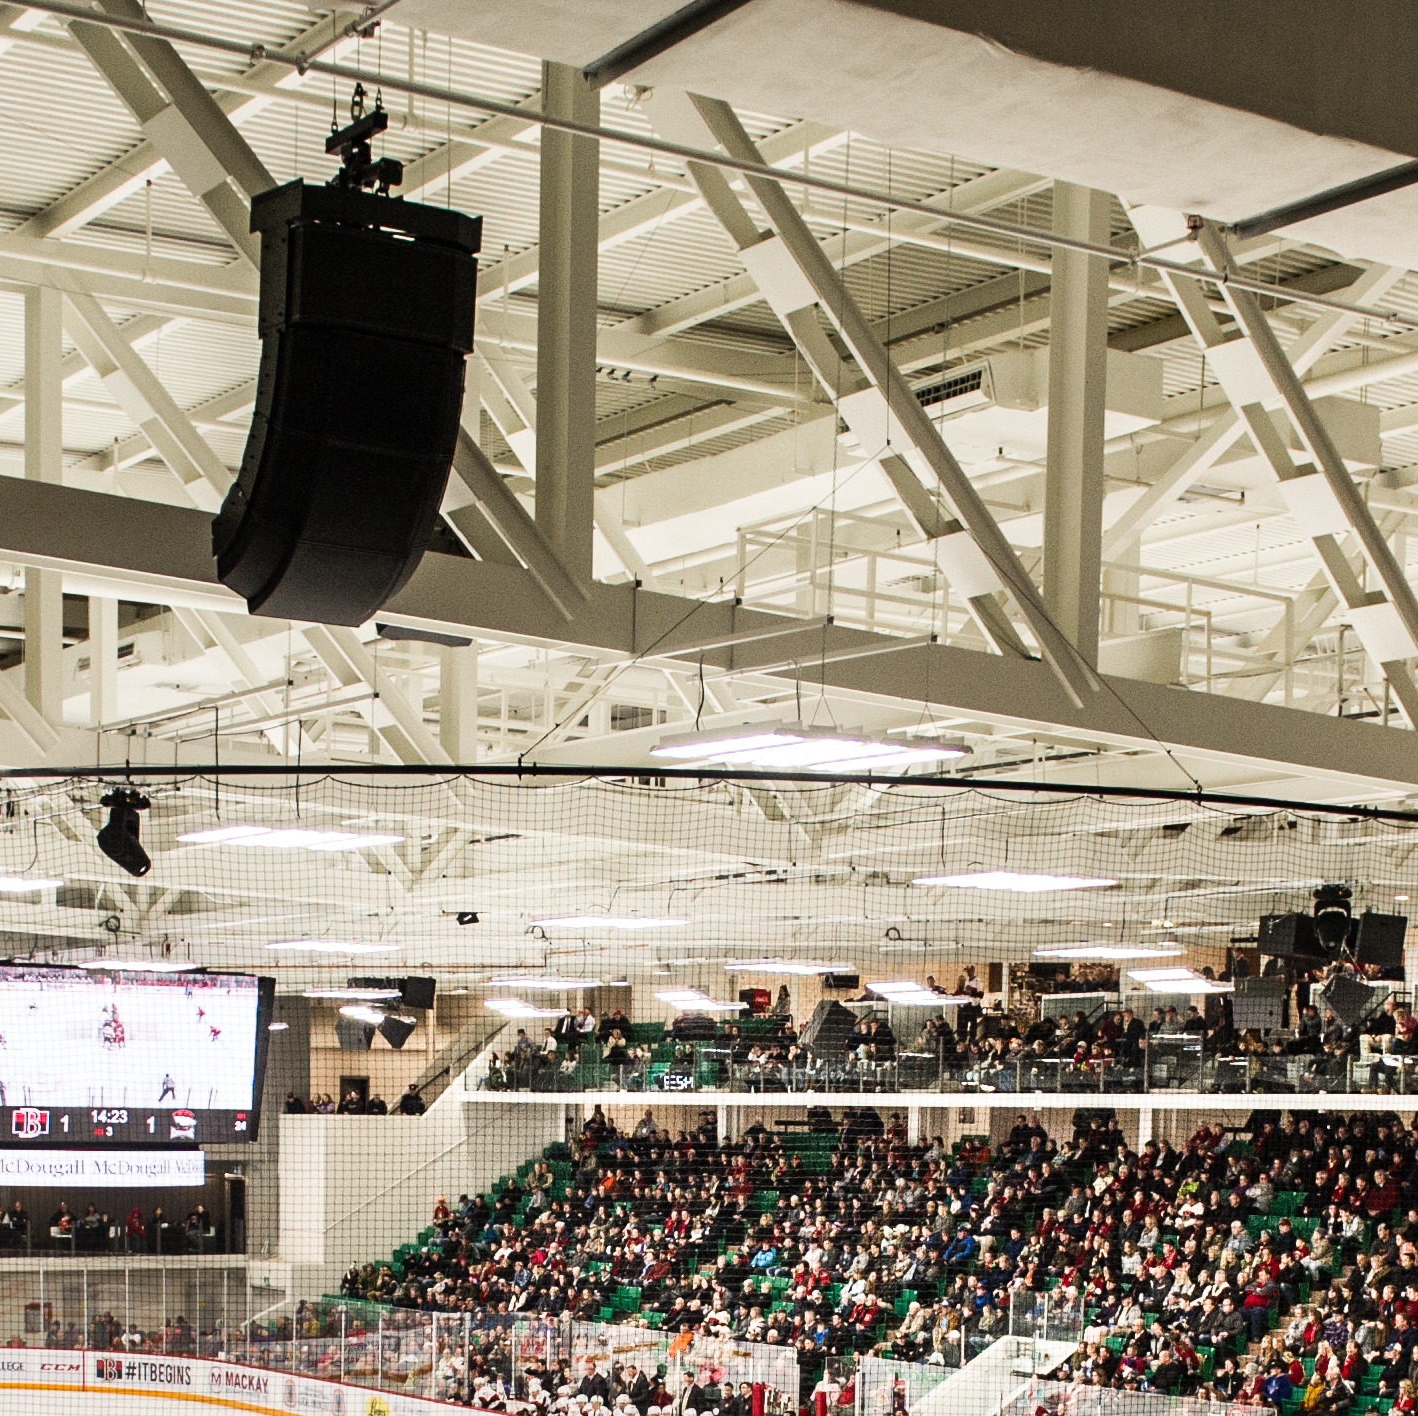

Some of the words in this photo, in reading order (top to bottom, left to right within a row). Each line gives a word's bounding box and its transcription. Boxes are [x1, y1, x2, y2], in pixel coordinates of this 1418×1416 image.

[60, 1114, 69, 1133] 1
[91, 1109, 129, 1124] 14:23
[146, 1115, 155, 1134] 1
[234, 1120, 248, 1132] 24
[105, 1126, 114, 1137] 3
[93, 1159, 170, 1178] McDougall
[40, 1363, 81, 1372] CCM
[124, 1361, 192, 1386] #ITBEGINS
[225, 1370, 269, 1394] MACKAY
